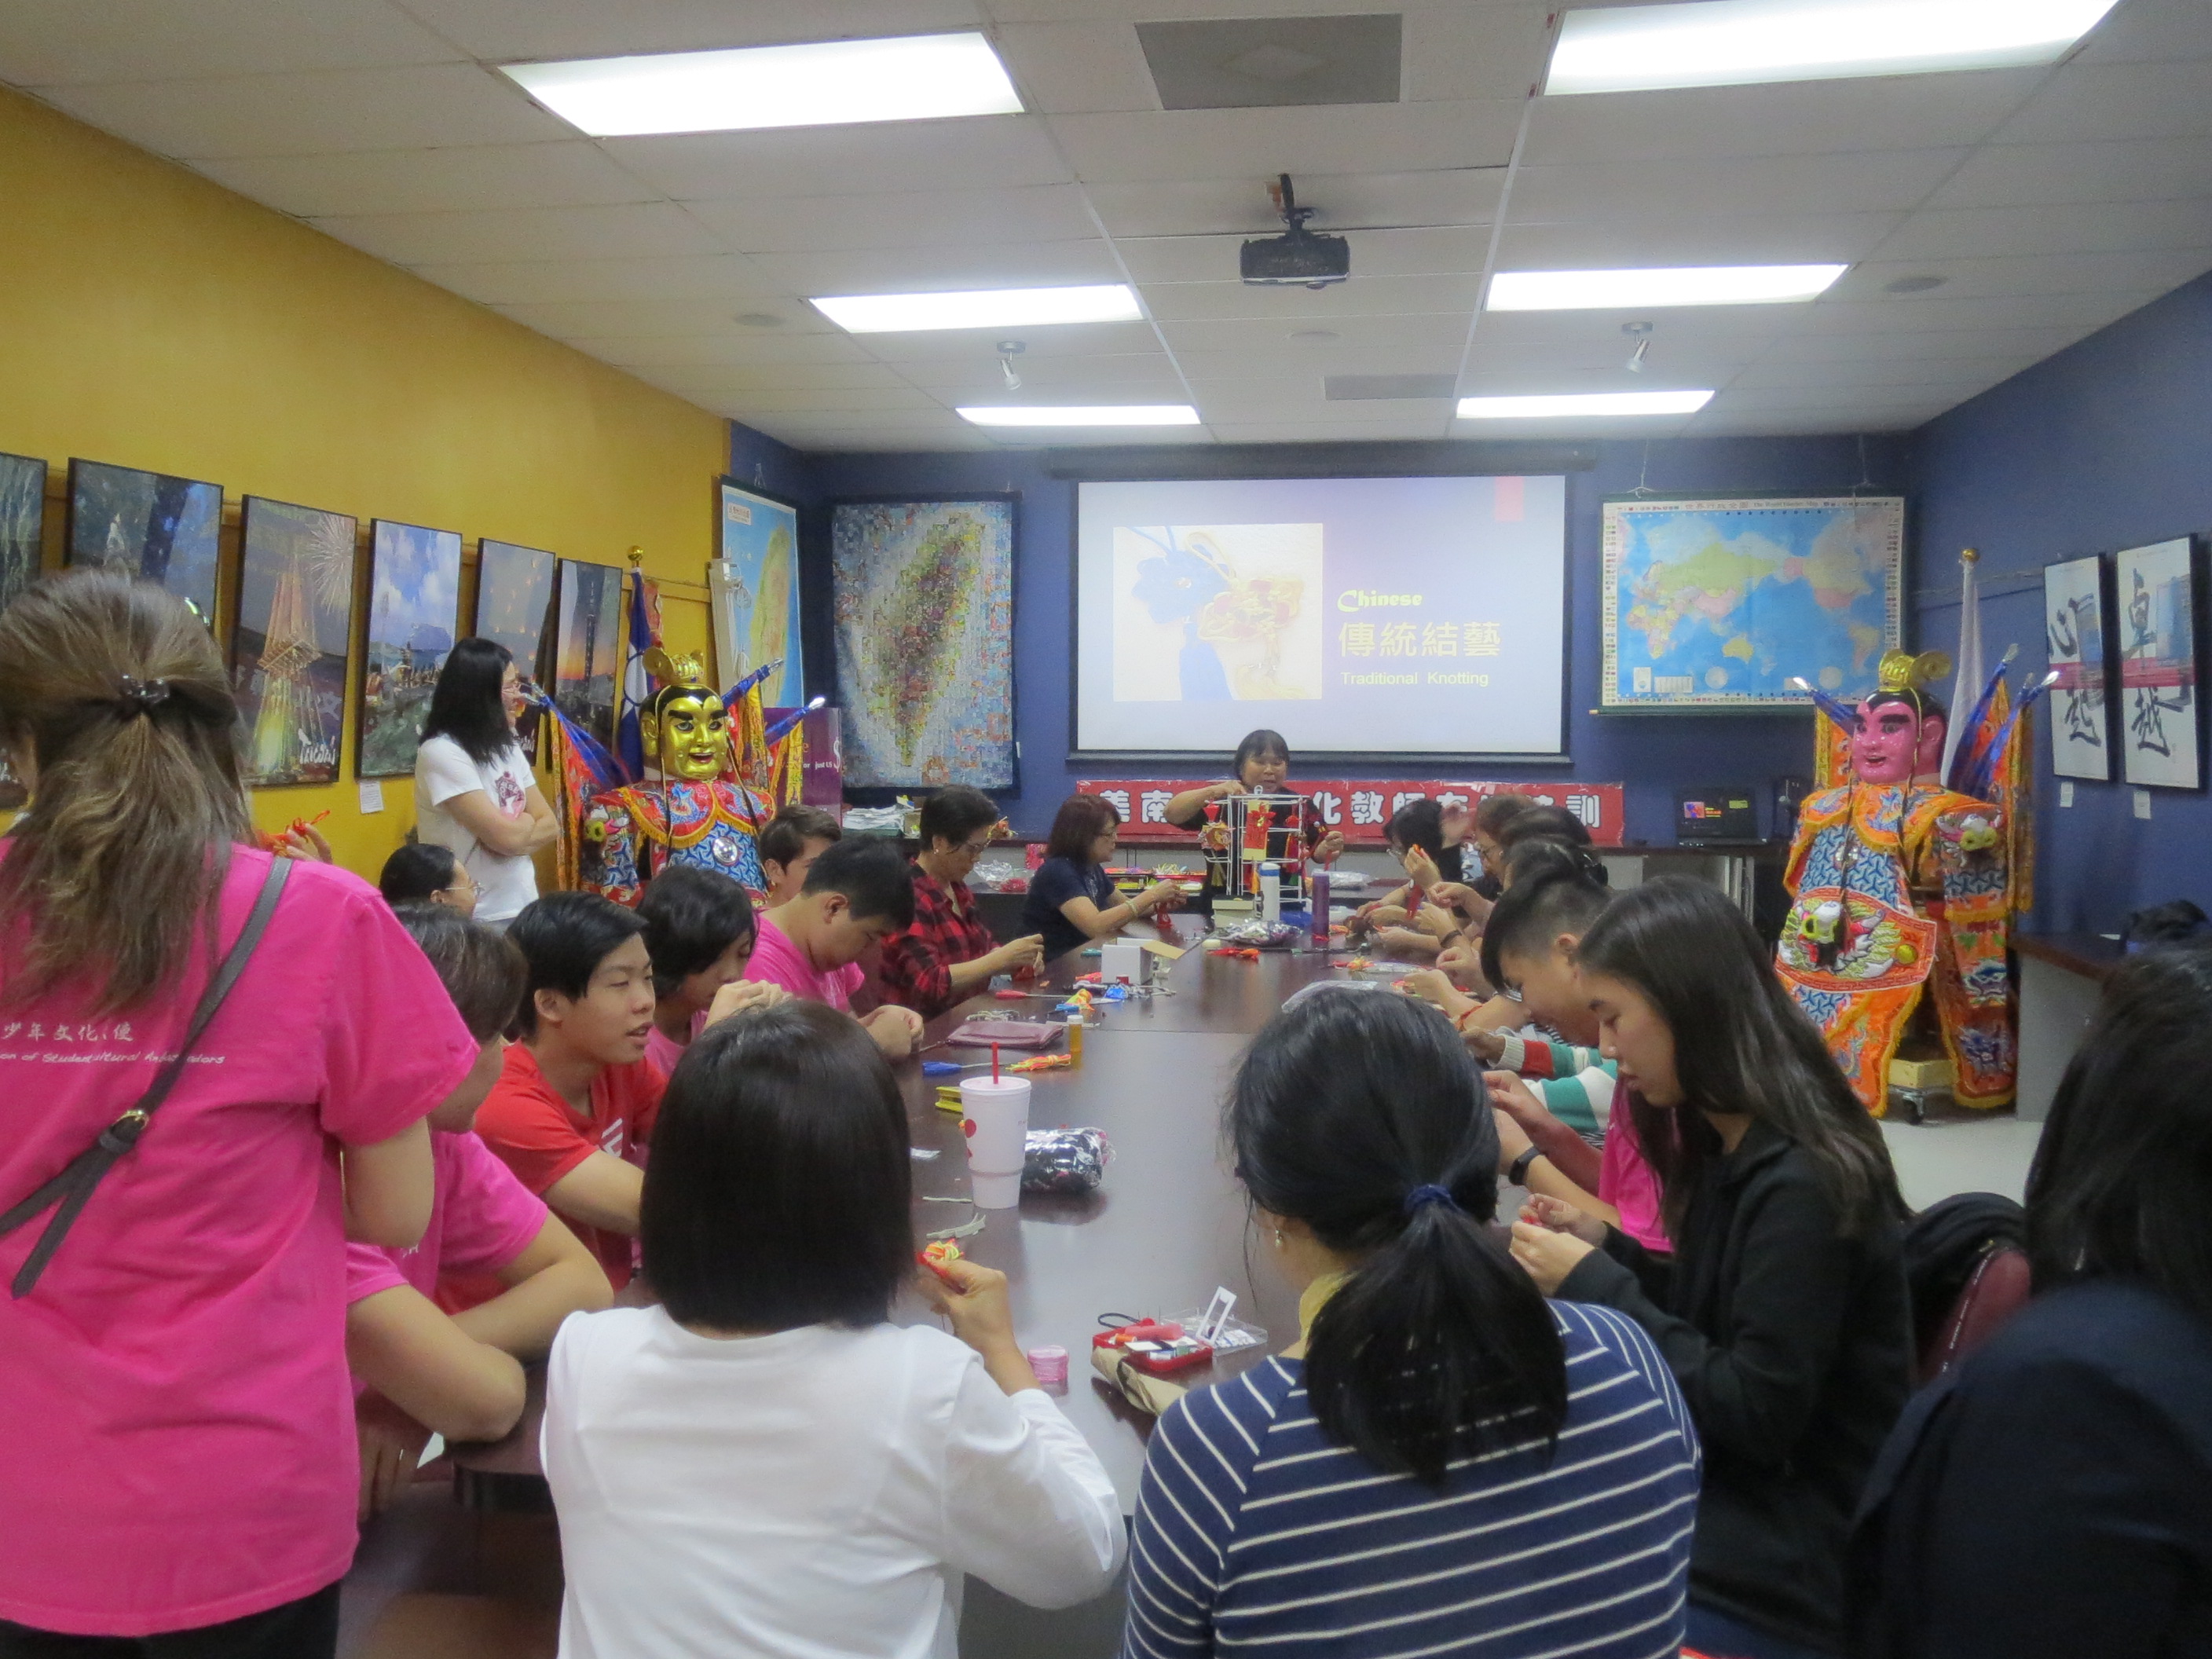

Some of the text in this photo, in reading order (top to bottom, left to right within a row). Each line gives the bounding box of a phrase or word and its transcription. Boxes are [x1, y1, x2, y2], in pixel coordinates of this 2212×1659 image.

[1337, 589, 1423, 613] Chinese
[1338, 621, 1501, 657] 傳統結藝
[1340, 672, 1489, 687] Traditional Knotting
[815, 761, 826, 770] just
[21, 1053, 39, 1061] of
[93, 1050, 141, 1062] ultural
